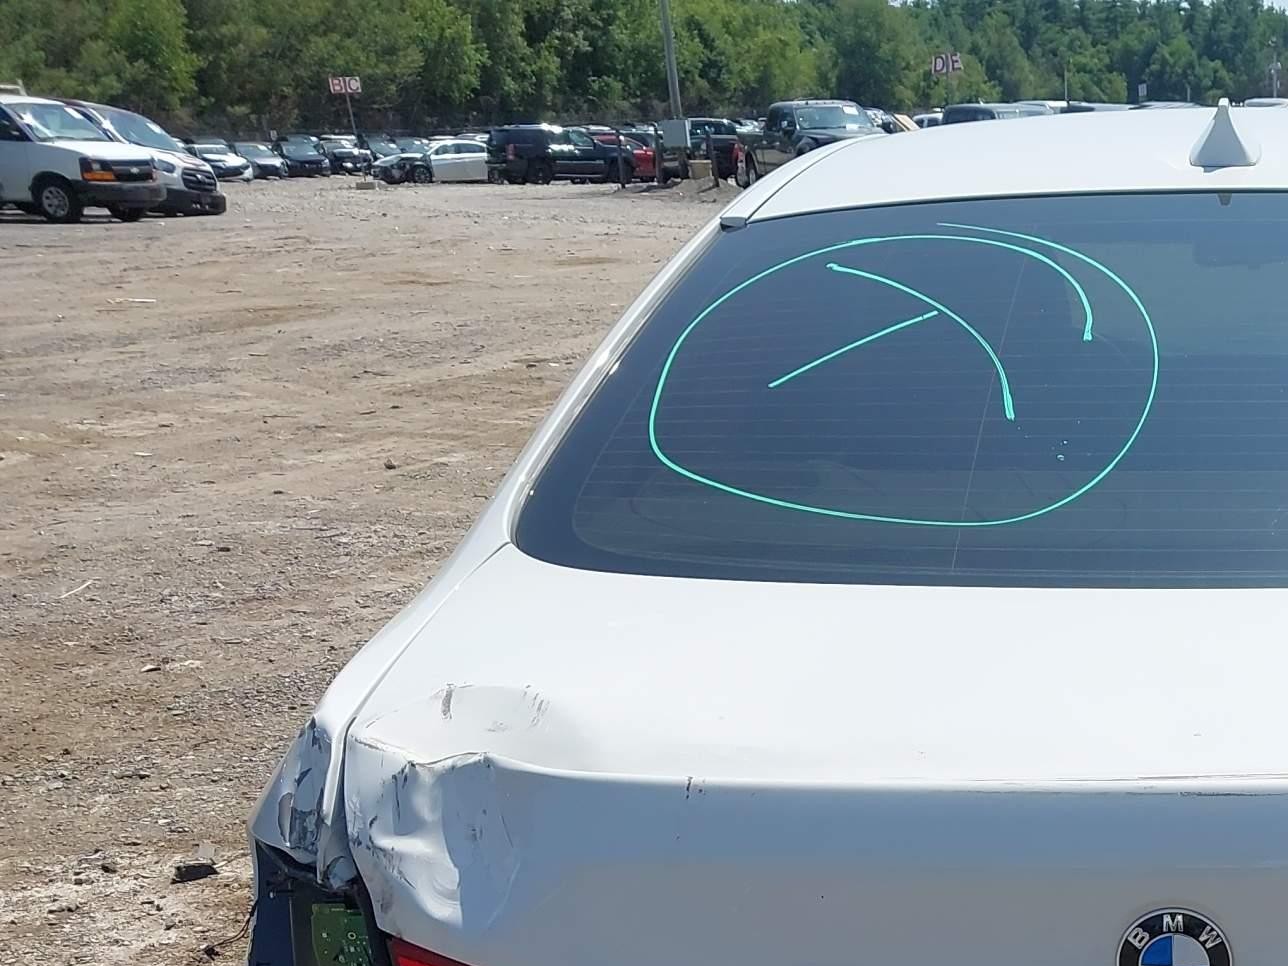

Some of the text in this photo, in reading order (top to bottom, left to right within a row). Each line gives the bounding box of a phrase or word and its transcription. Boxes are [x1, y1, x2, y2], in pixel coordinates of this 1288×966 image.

[934, 56, 945, 73] D
[951, 53, 962, 71] E
[331, 78, 343, 92] B
[348, 78, 360, 92] C
[1127, 913, 1222, 950] BMW
